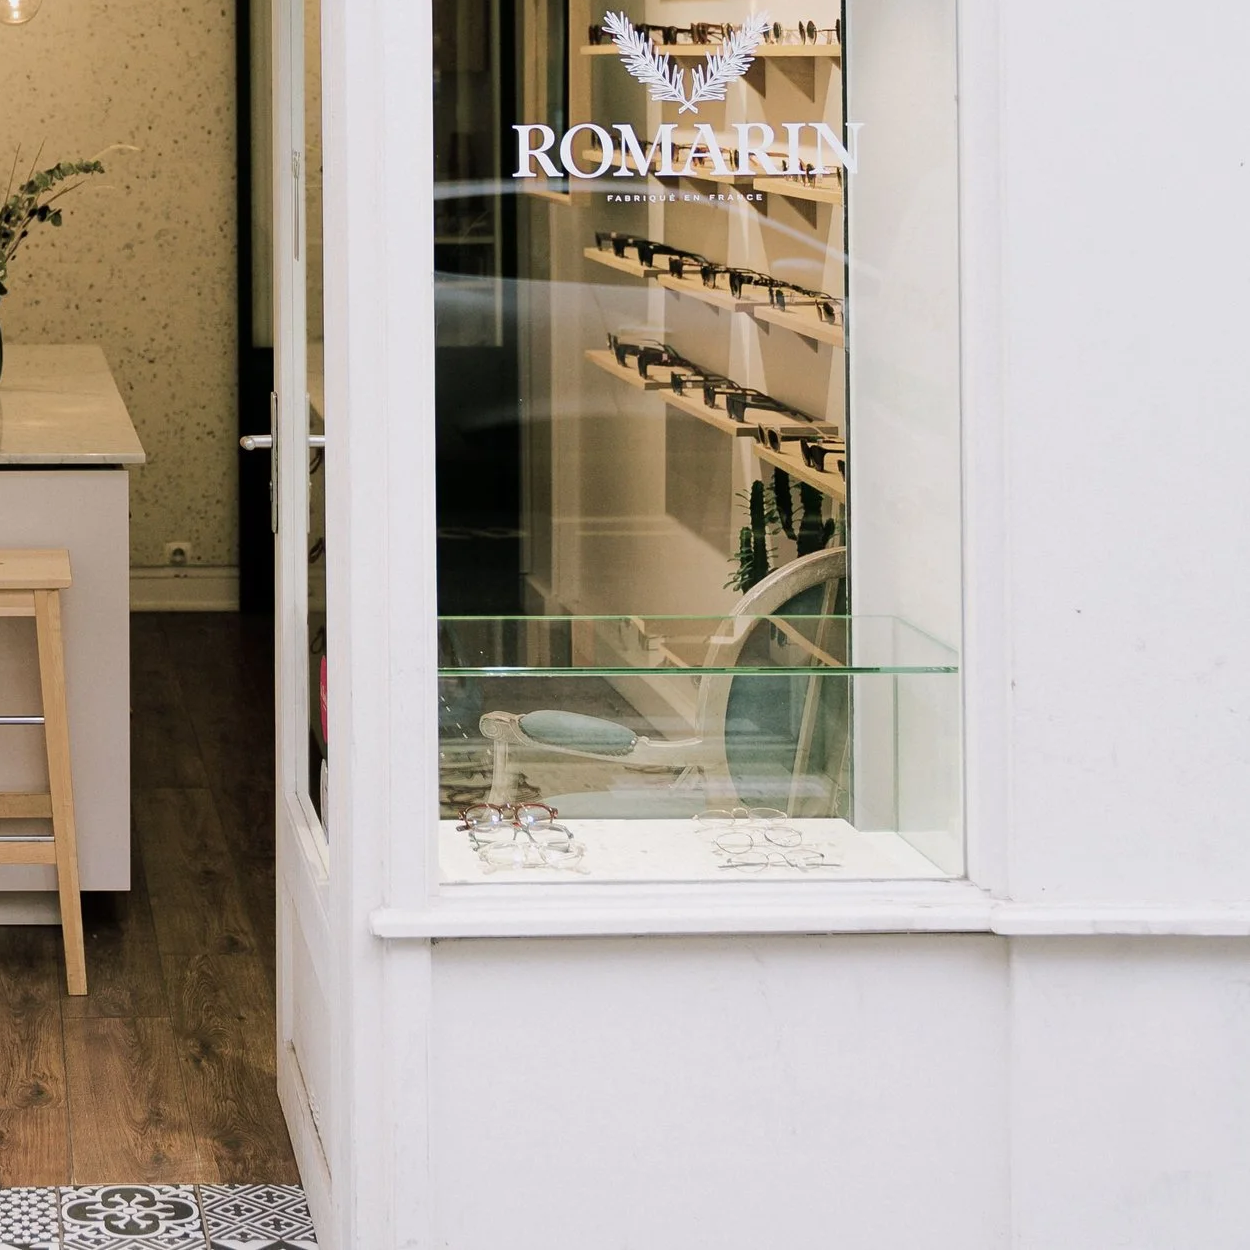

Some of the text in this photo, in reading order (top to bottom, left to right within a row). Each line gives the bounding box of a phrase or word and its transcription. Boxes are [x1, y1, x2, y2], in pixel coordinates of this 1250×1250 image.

[512, 122, 865, 180] ROMARIN
[607, 193, 676, 203] FABRIQUÉ
[709, 193, 763, 201] FRANCE
